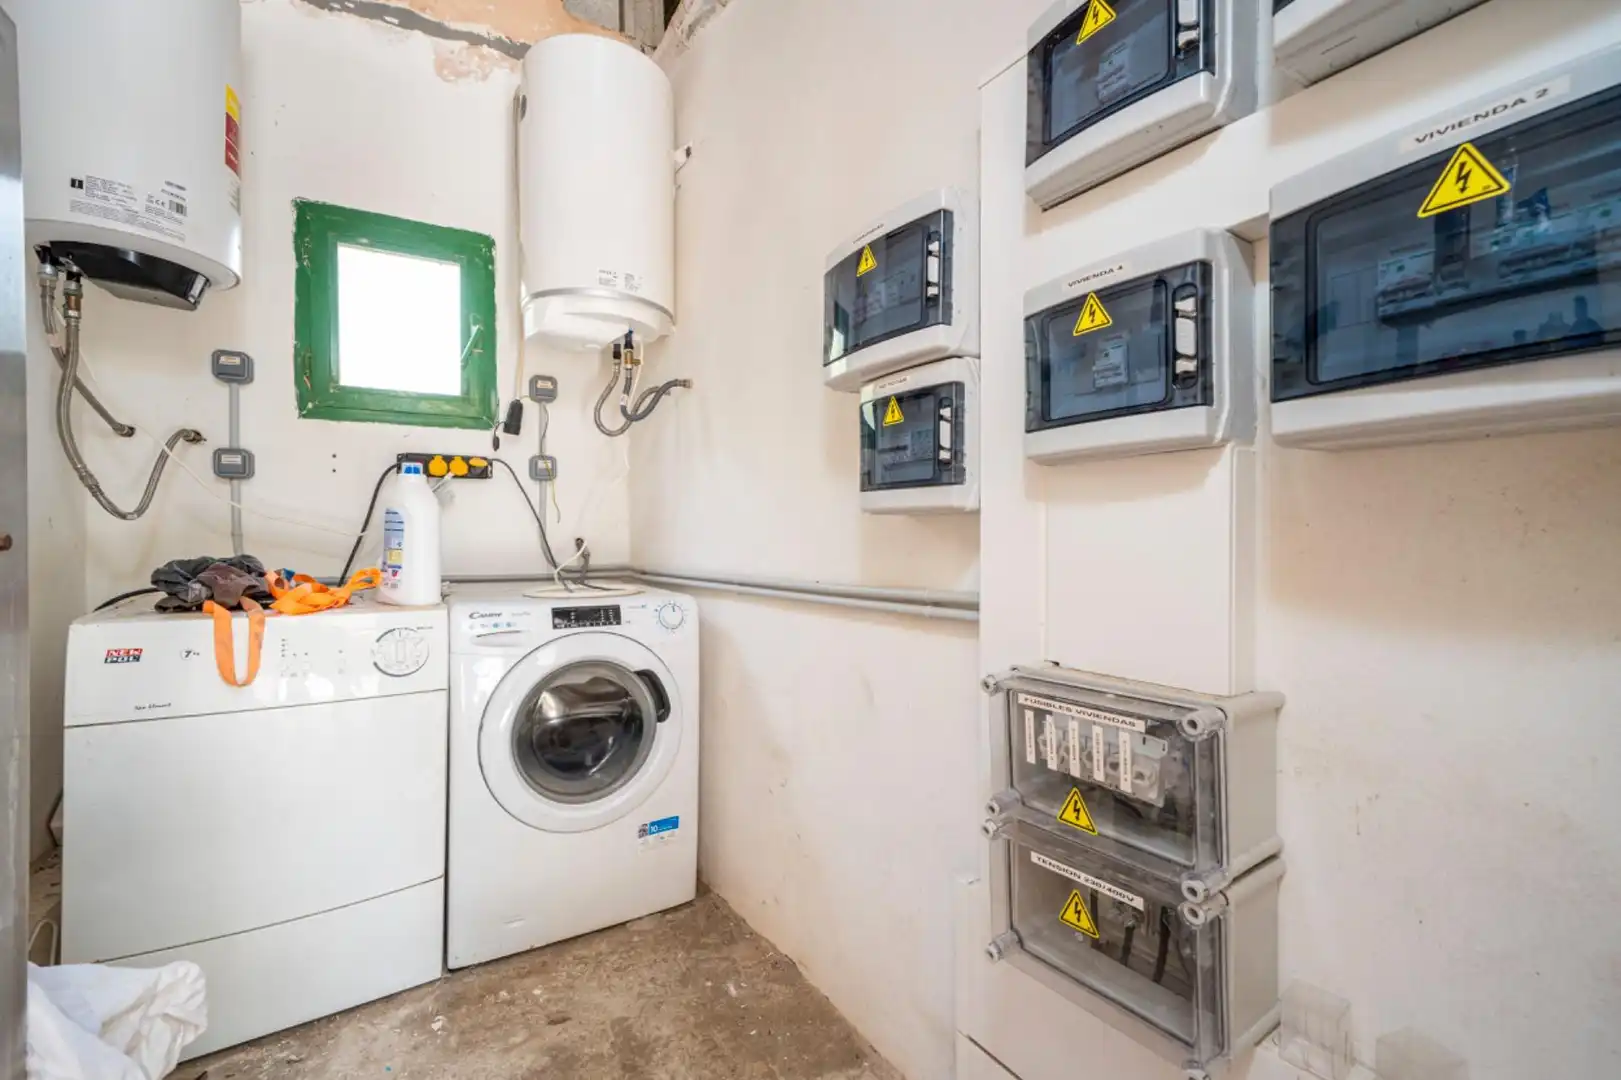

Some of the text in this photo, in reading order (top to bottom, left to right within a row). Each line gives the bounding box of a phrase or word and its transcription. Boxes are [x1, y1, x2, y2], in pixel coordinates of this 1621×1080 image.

[1414, 87, 1549, 143] VIVIENDA 2
[1068, 268, 1115, 287] VIVIENDA
[107, 648, 143, 656] NEW
[1023, 697, 1136, 728] FUSIBLES VIVIENDAS
[1037, 856, 1135, 902] TENSION 230/400V
